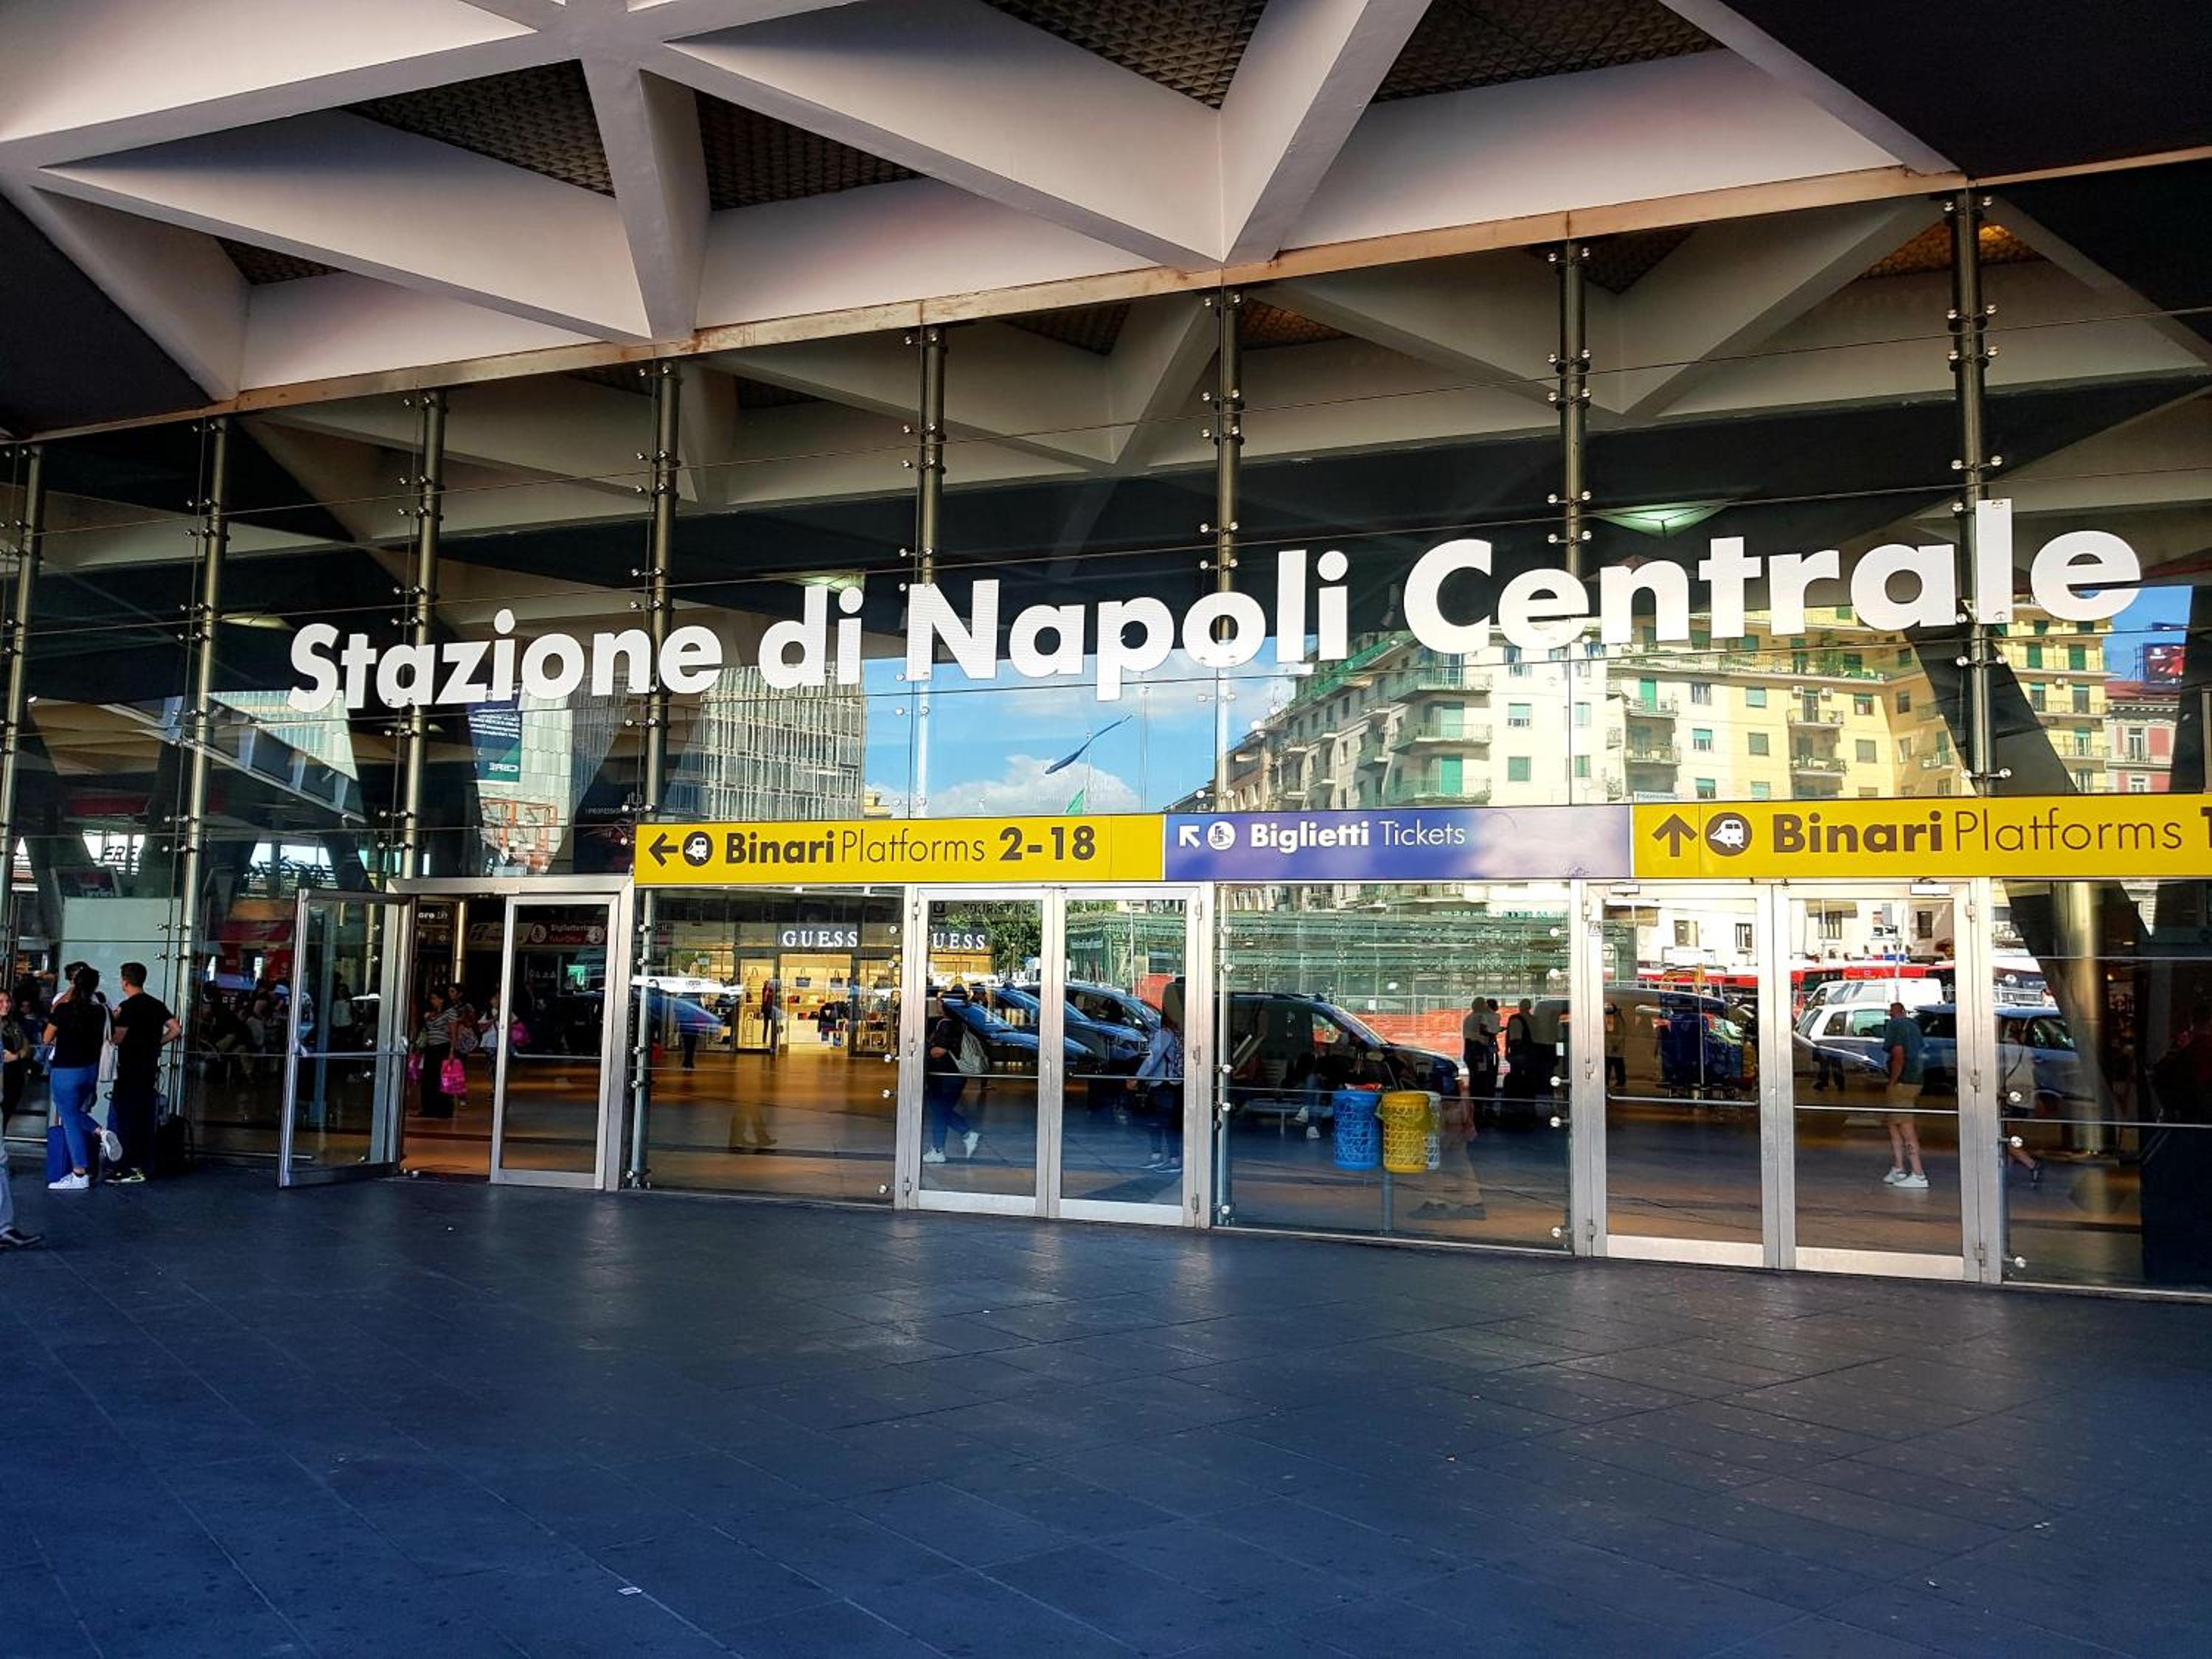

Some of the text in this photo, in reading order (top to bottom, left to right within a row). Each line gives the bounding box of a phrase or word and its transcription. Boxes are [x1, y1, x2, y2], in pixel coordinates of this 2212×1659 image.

[287, 498, 2142, 714] Stazione di Napoli Centrale
[1250, 819, 1466, 854] Biglietti Tickets
[1773, 811, 1943, 853] Binari
[1955, 807, 2183, 852] Platforms
[725, 825, 1096, 864] Binari Platforms 2-18
[962, 902, 1013, 916] TOURIST
[550, 923, 591, 933] Biglietteri
[782, 931, 858, 947] GUESS
[931, 933, 986, 950] UESS
